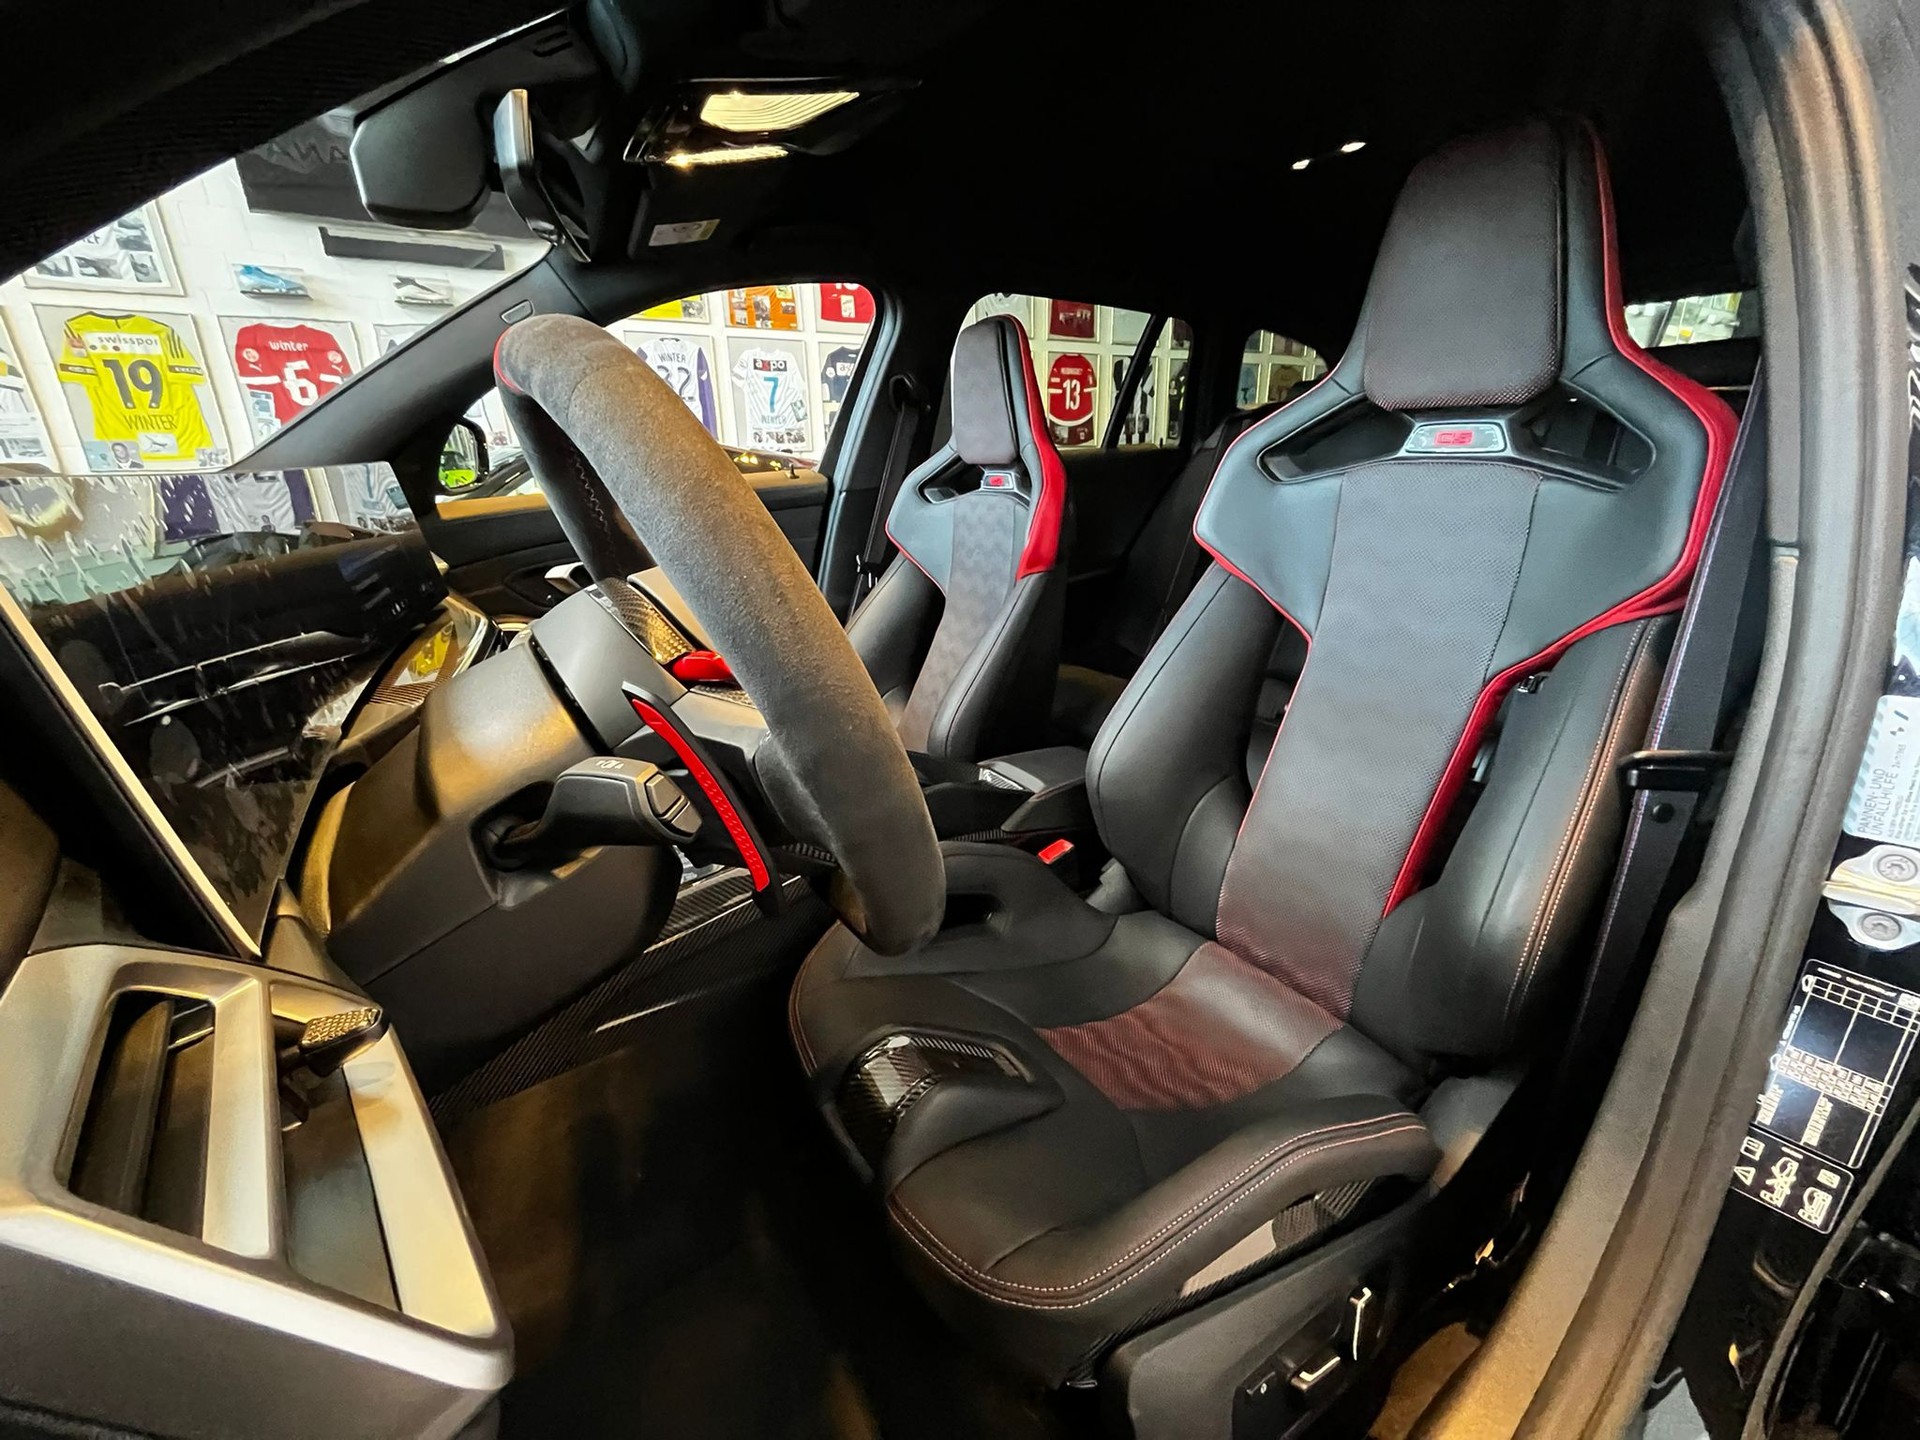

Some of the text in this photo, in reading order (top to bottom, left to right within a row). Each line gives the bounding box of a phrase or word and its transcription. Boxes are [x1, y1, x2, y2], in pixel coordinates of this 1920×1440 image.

[268, 340, 309, 352] winter
[657, 353, 687, 363] WINTER
[102, 358, 164, 410] 19
[282, 359, 319, 407] 6
[763, 376, 779, 413] 7
[1062, 378, 1081, 410] 13
[123, 414, 178, 431] WINTER
[1857, 768, 1885, 835] PANNEN- UND
[1870, 772, 1899, 837] UNFALLHILFE
